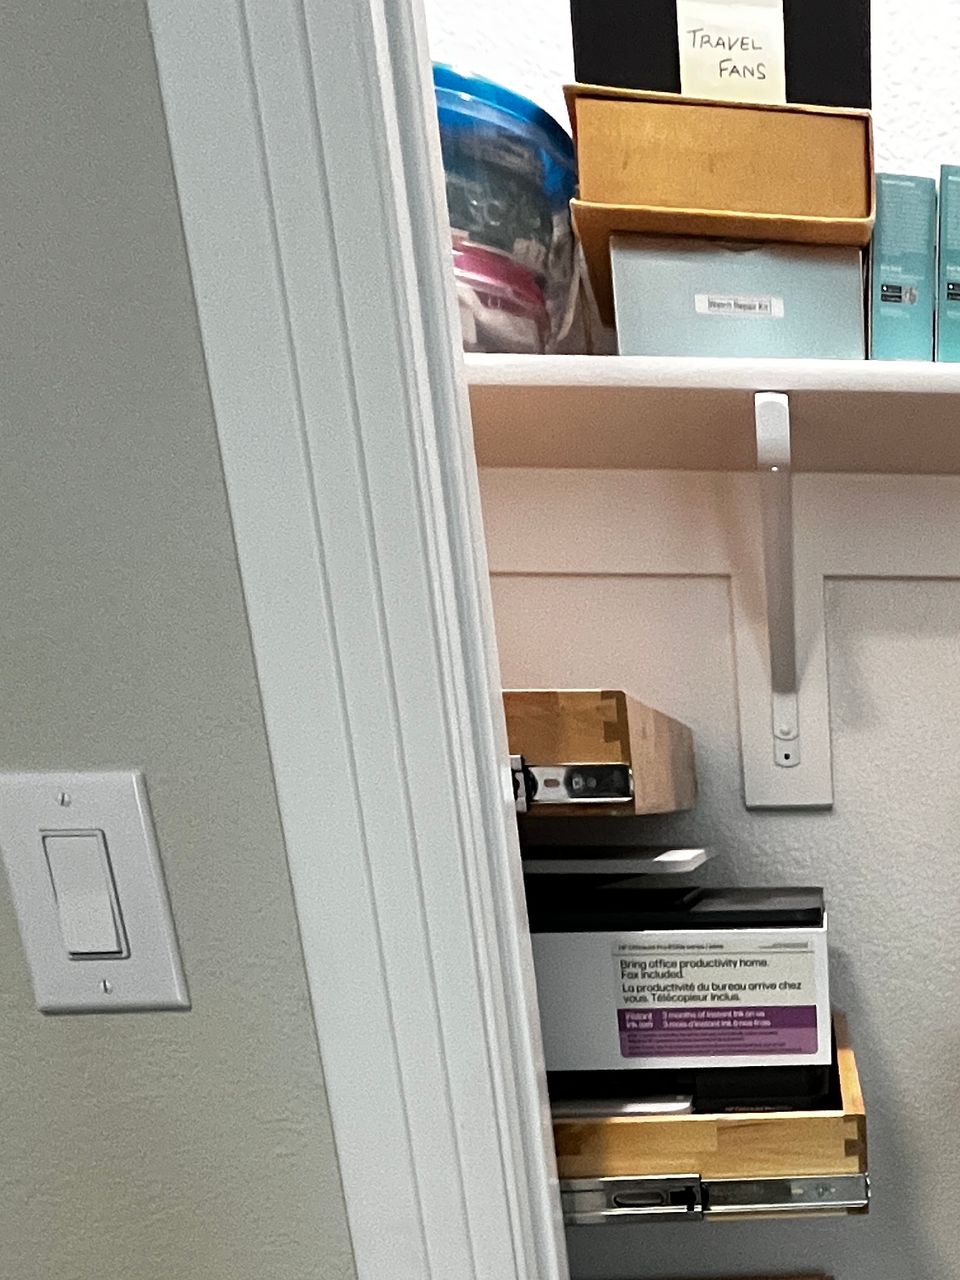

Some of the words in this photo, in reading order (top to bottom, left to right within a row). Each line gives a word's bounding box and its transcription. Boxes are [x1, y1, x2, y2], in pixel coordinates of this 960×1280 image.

[686, 28, 763, 51] TRAVEL
[719, 58, 766, 80] FANS
[620, 959, 647, 970] Bring
[648, 959, 678, 968] office
[680, 959, 738, 969] productivity
[622, 984, 635, 993] La
[637, 983, 696, 994] productivité
[697, 983, 710, 992] du
[712, 982, 746, 992] bureau
[778, 981, 802, 991] chez
